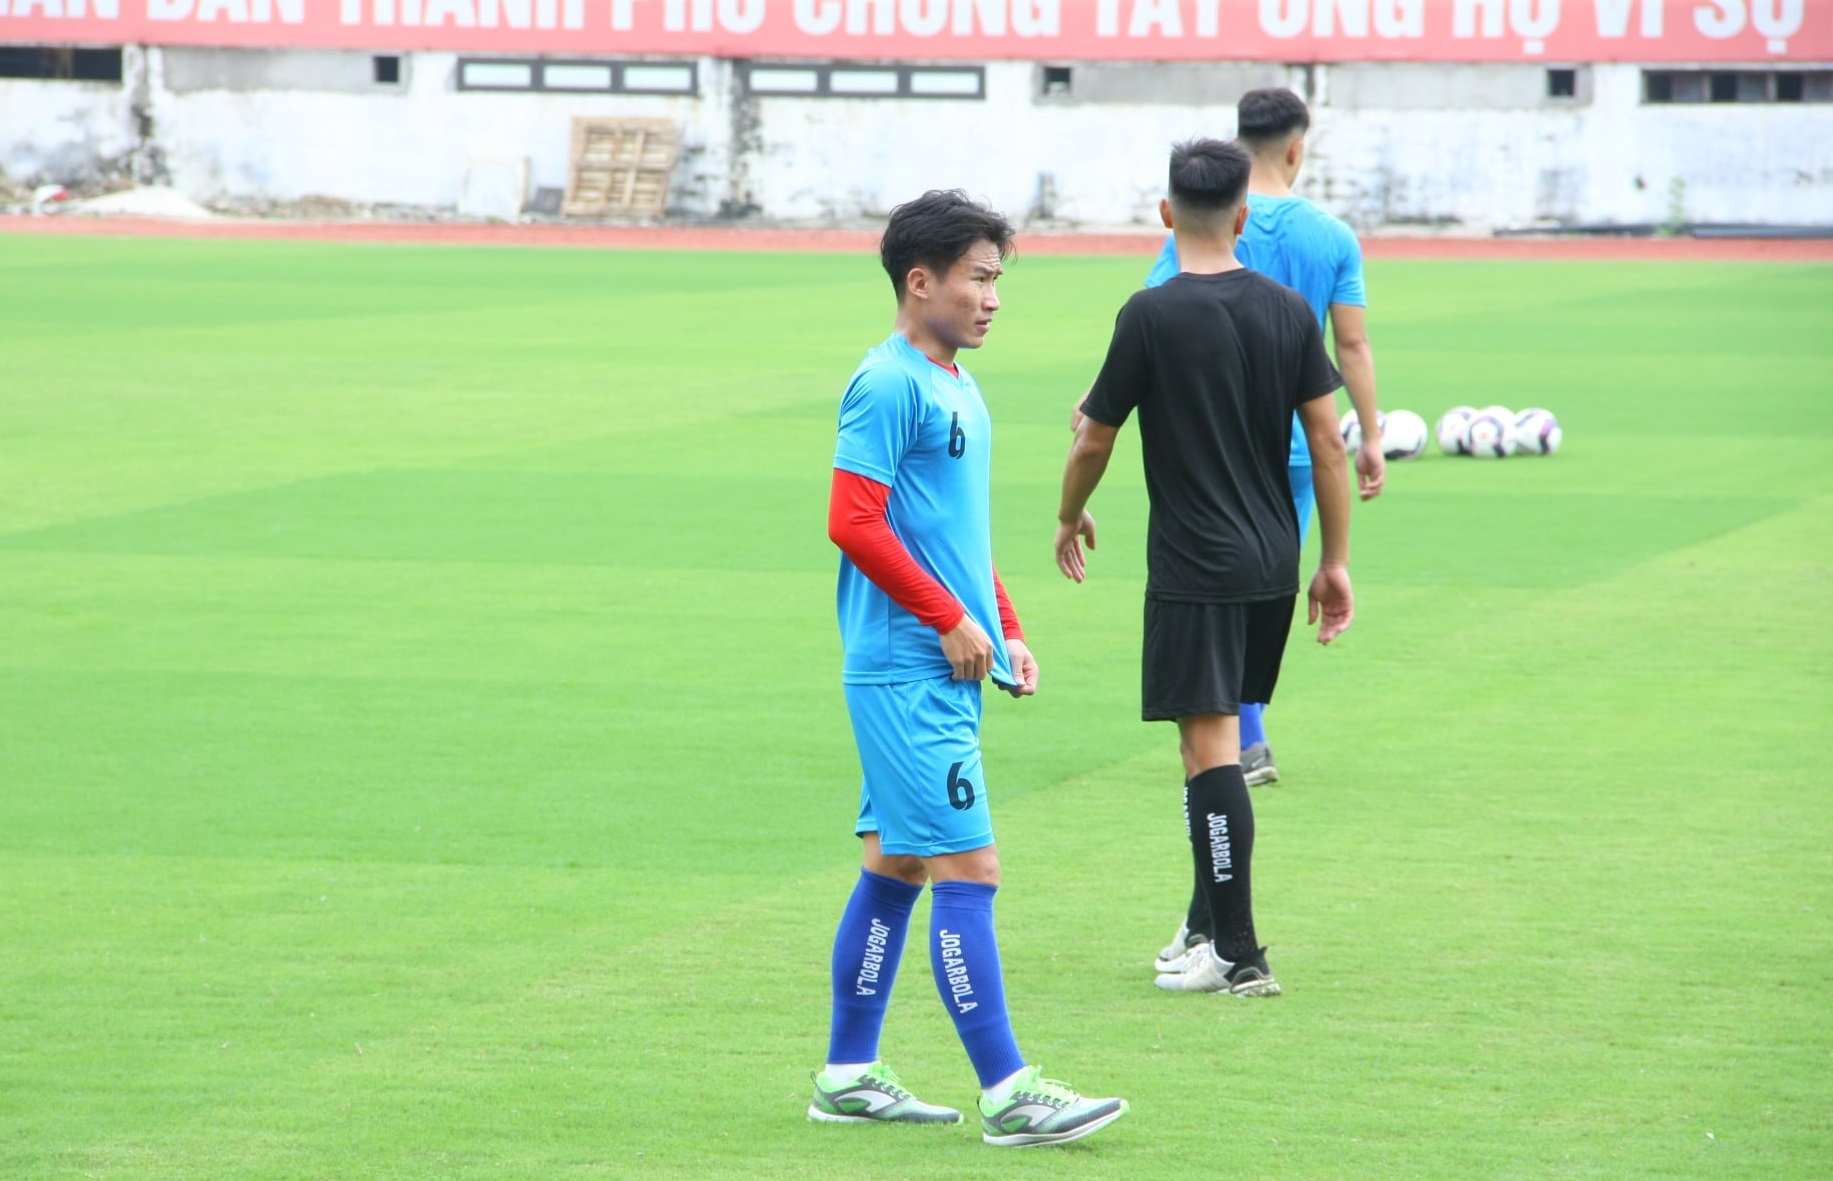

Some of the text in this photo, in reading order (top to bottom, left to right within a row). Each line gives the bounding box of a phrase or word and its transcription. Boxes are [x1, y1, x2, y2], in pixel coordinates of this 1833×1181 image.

[949, 411, 966, 460] 6
[946, 761, 976, 811] 6
[1206, 812, 1234, 884] JOGARBOLA
[855, 917, 891, 997] JOGARBOLA
[939, 929, 979, 1015] JOGARBOLA
